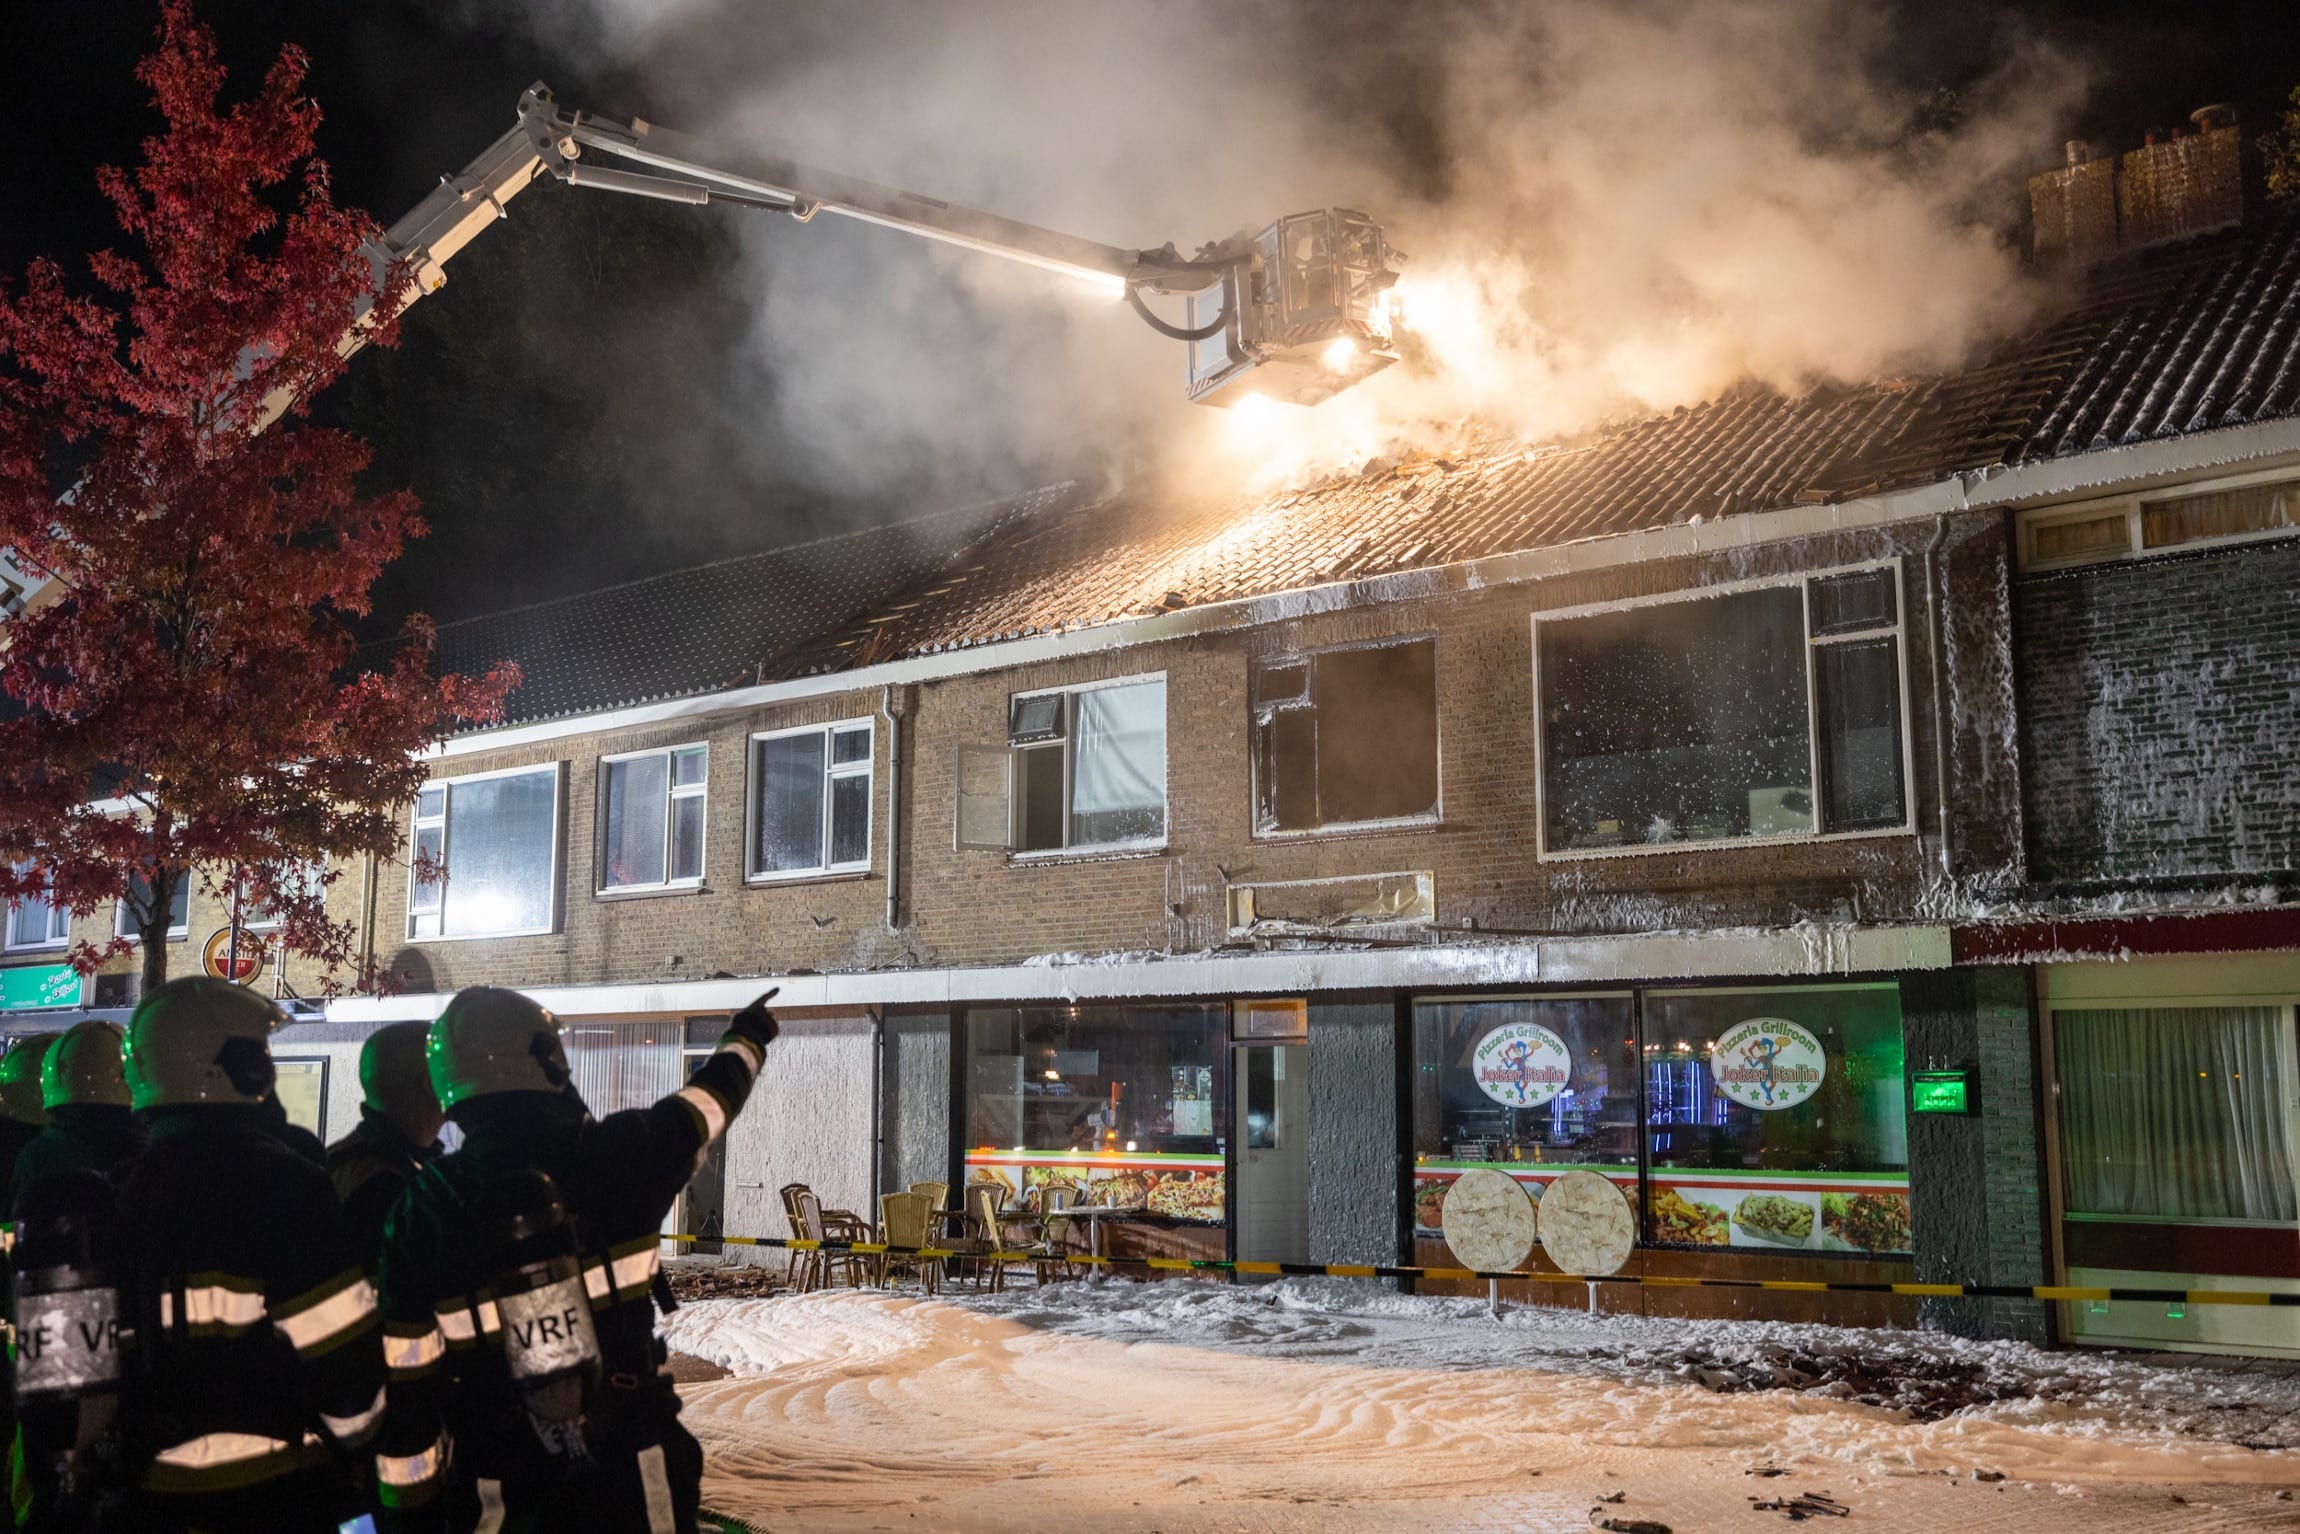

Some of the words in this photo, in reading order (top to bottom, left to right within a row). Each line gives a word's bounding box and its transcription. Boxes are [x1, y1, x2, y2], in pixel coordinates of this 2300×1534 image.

[1478, 1029, 1514, 1060] Pizzeria
[1516, 1026, 1564, 1056] Grillroom
[1717, 1025, 1759, 1059] Pizzeria
[1761, 1021, 1817, 1054] Grillroom
[1479, 1065, 1522, 1083] Joker
[1524, 1065, 1565, 1083] Italia
[1719, 1063, 1768, 1083] Joker
[1772, 1063, 1820, 1083] Italia
[512, 1306, 579, 1350] VRF
